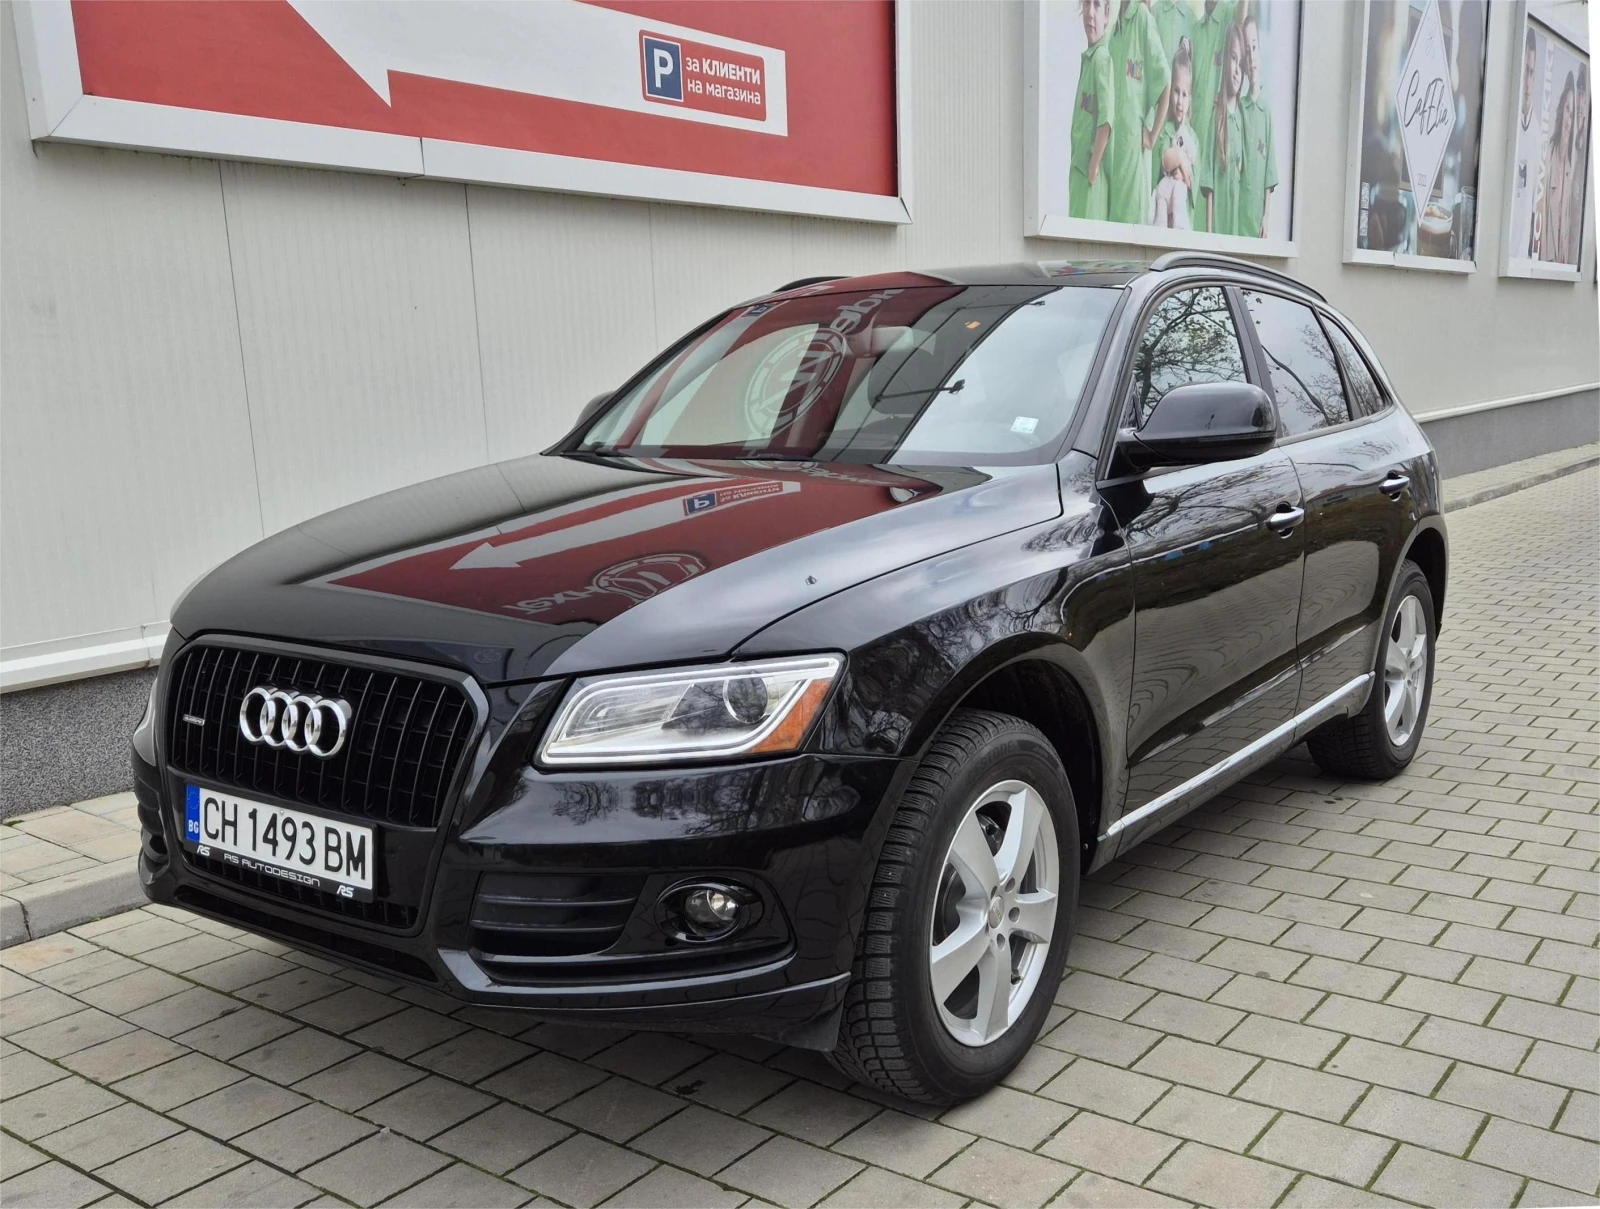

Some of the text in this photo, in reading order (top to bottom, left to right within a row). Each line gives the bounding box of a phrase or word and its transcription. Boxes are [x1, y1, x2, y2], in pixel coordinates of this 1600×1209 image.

[653, 48, 674, 88] P
[685, 57, 761, 85] за КЛИЕНТИ
[687, 79, 761, 105] на магазина
[188, 819, 200, 834] BG
[203, 797, 366, 880] CH 1493 BM
[241, 858, 321, 887] AUTODESIGN
